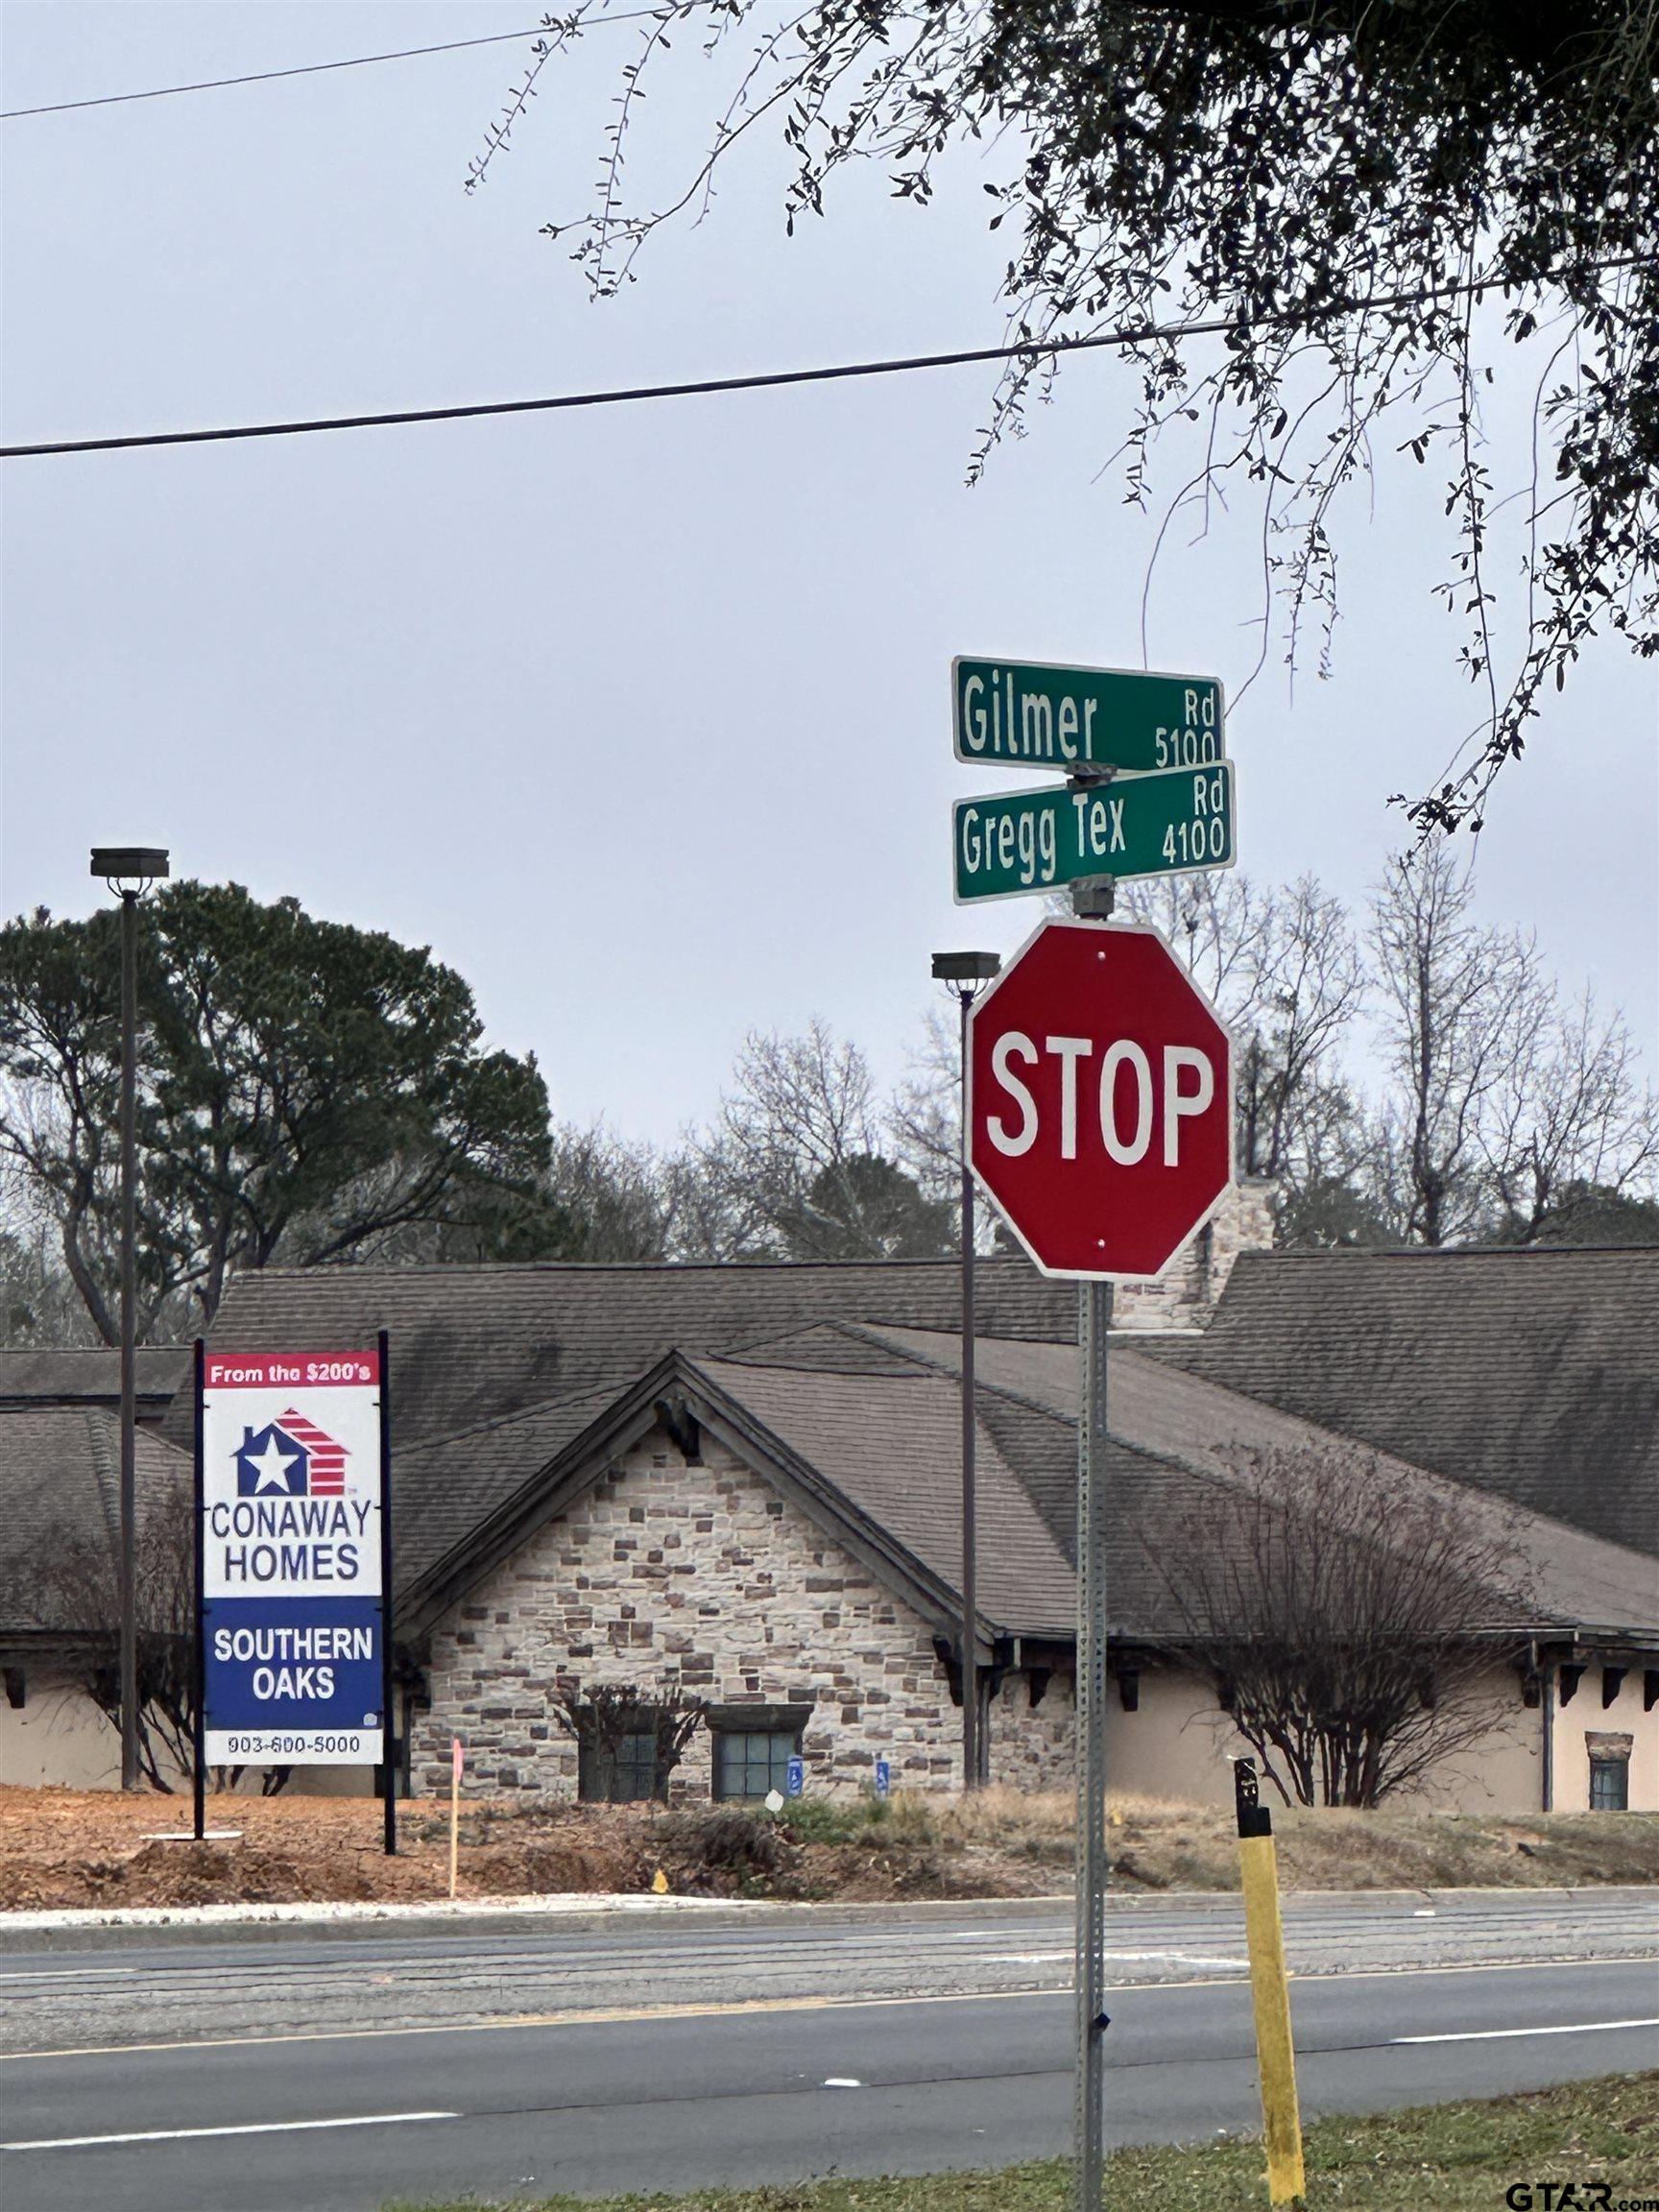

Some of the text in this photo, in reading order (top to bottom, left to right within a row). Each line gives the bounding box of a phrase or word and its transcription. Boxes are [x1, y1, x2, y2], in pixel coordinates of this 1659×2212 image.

[964, 669, 1215, 760] Gilmer Rd
[1155, 727, 1215, 768] 5100
[963, 769, 1224, 884] Gregg Tex Rd
[1162, 816, 1224, 863] 4100
[986, 1030, 1214, 1167] STOP
[210, 1362, 372, 1382] From the $200's
[211, 1499, 372, 1538] CONAWAY
[225, 1543, 359, 1581] HOMES
[214, 1626, 373, 1662] SOUTHERN
[252, 1666, 335, 1700] OAKS
